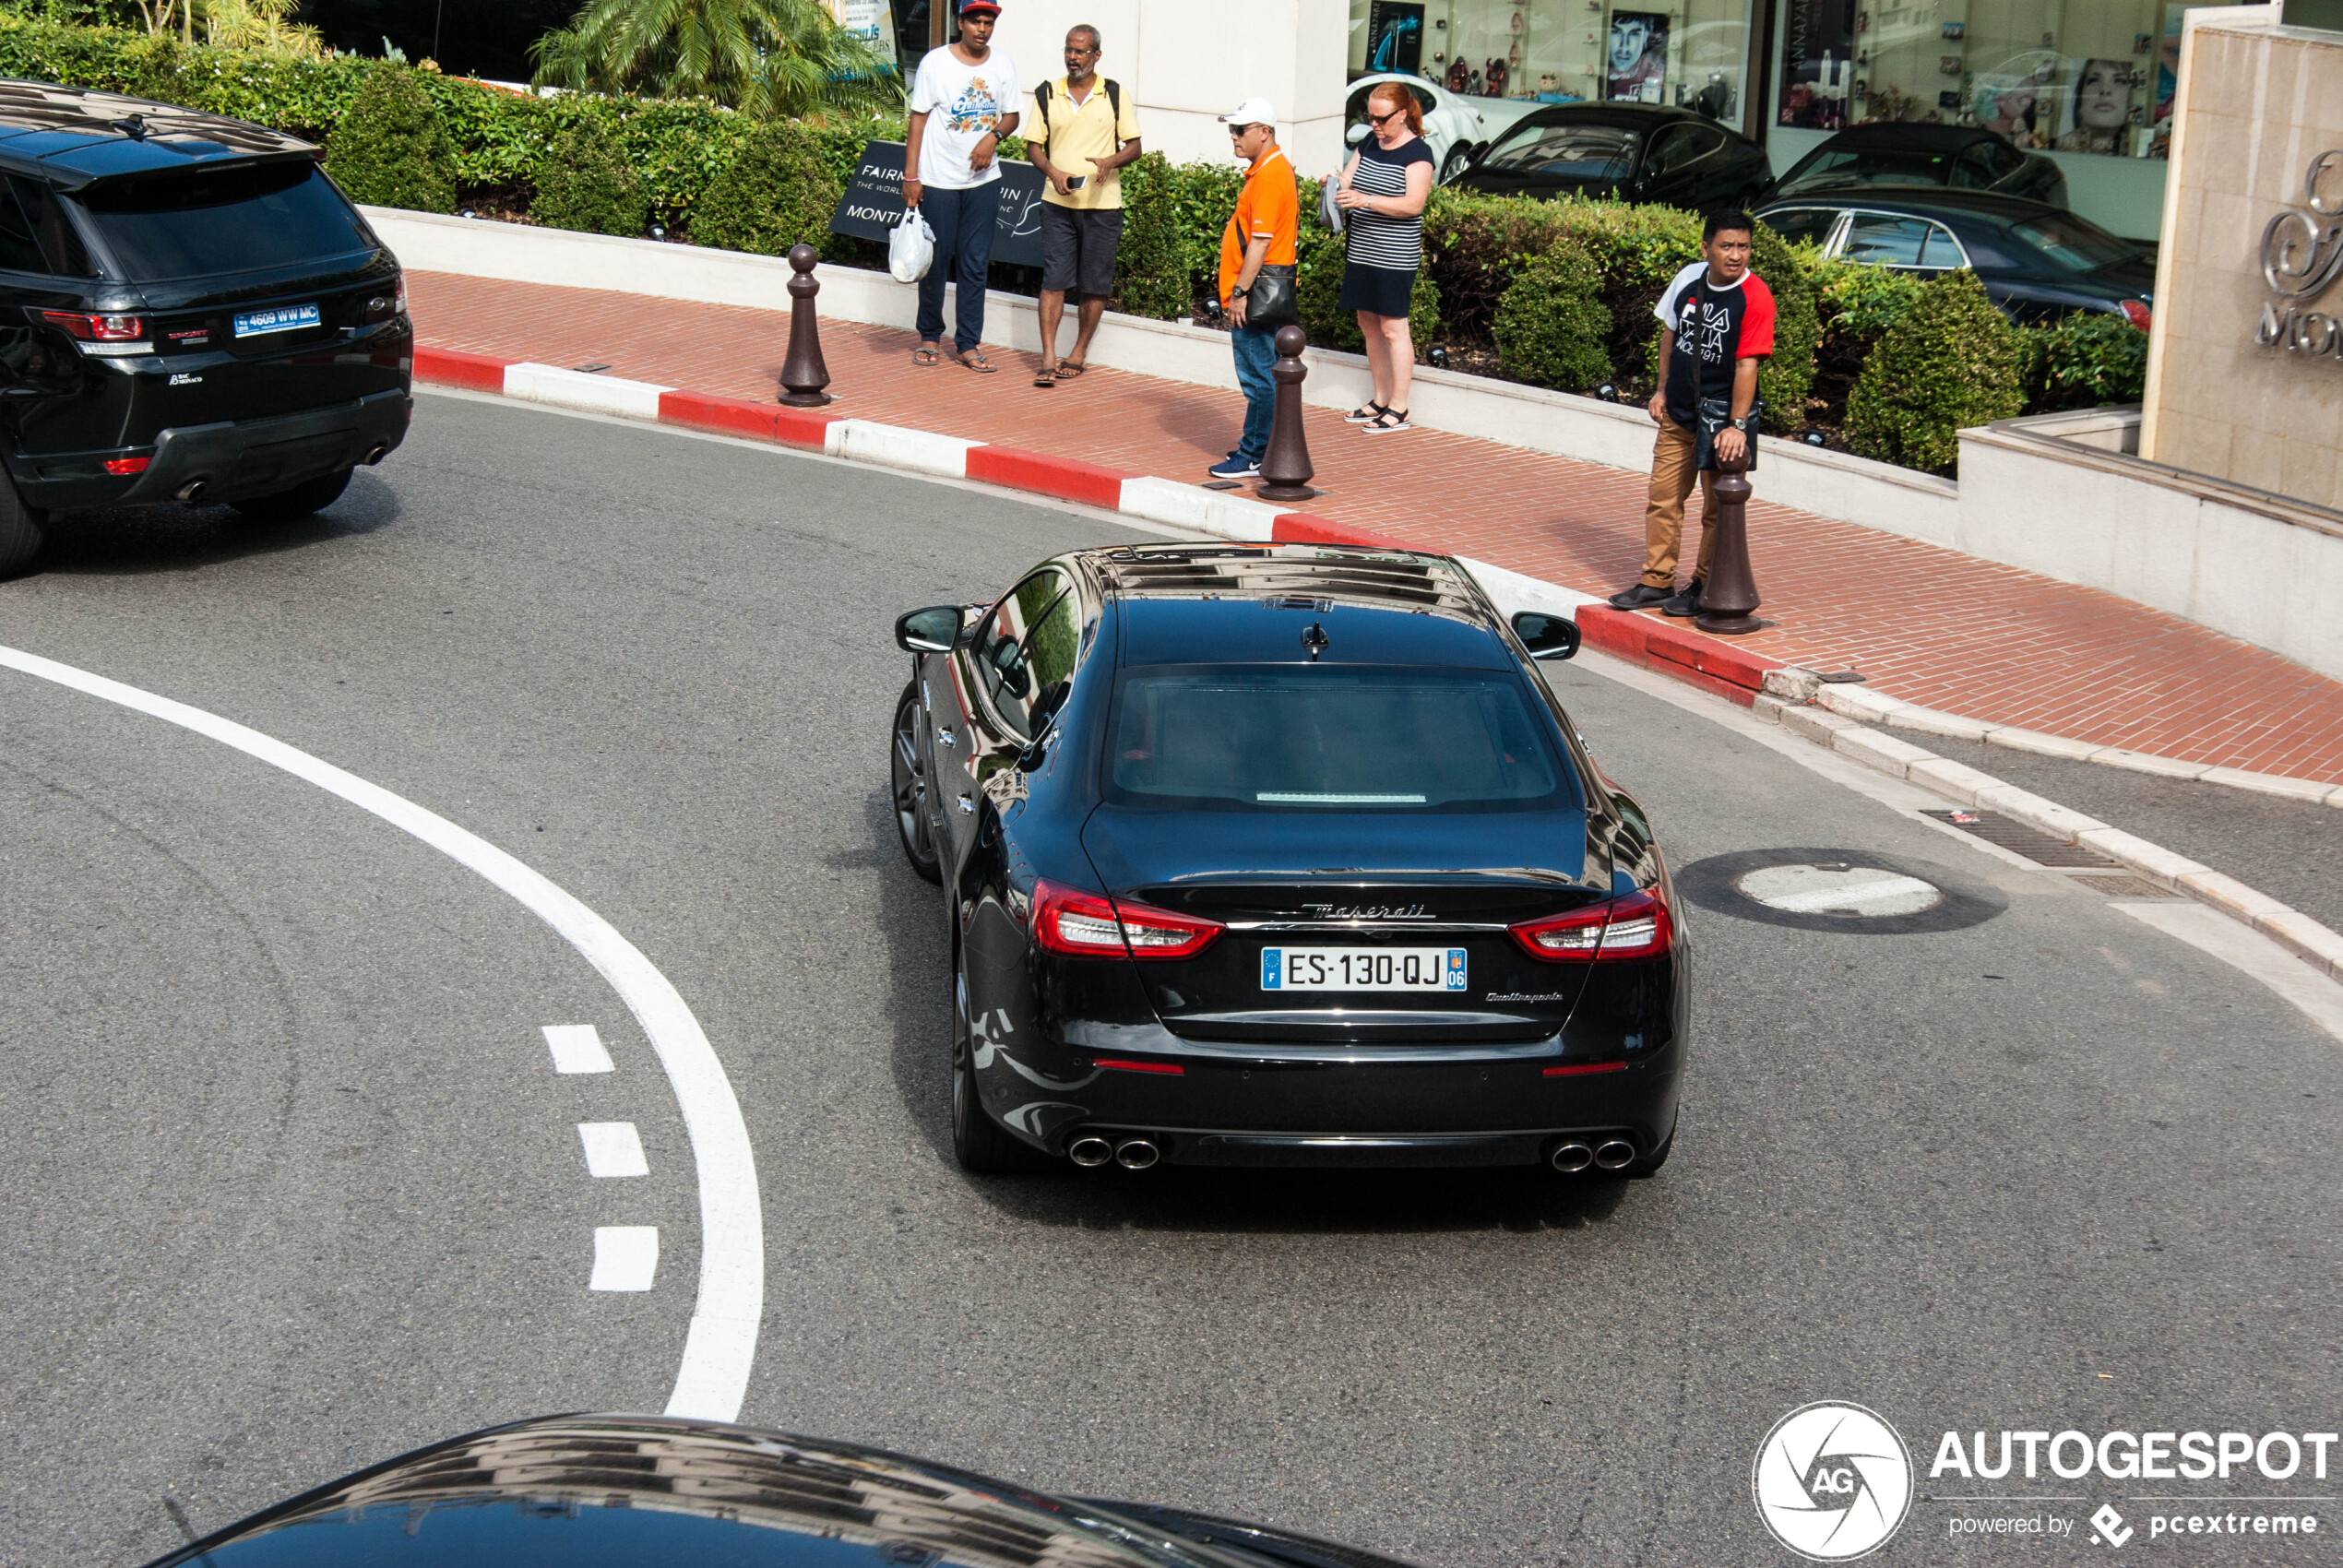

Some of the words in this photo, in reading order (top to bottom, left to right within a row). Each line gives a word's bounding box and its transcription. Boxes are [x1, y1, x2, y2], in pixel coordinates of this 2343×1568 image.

[1791, 0, 1809, 69] ANNAYA
[856, 181, 874, 190] THE
[875, 184, 903, 195] WORL
[249, 313, 276, 327] 4609
[277, 308, 298, 322] WW
[299, 305, 317, 319] MC
[178, 376, 203, 385] MONACO
[1302, 904, 1437, 919] Maserati
[1268, 972, 1276, 982] F
[1289, 954, 1441, 985] ES-130-QJ
[1448, 971, 1465, 986] 06
